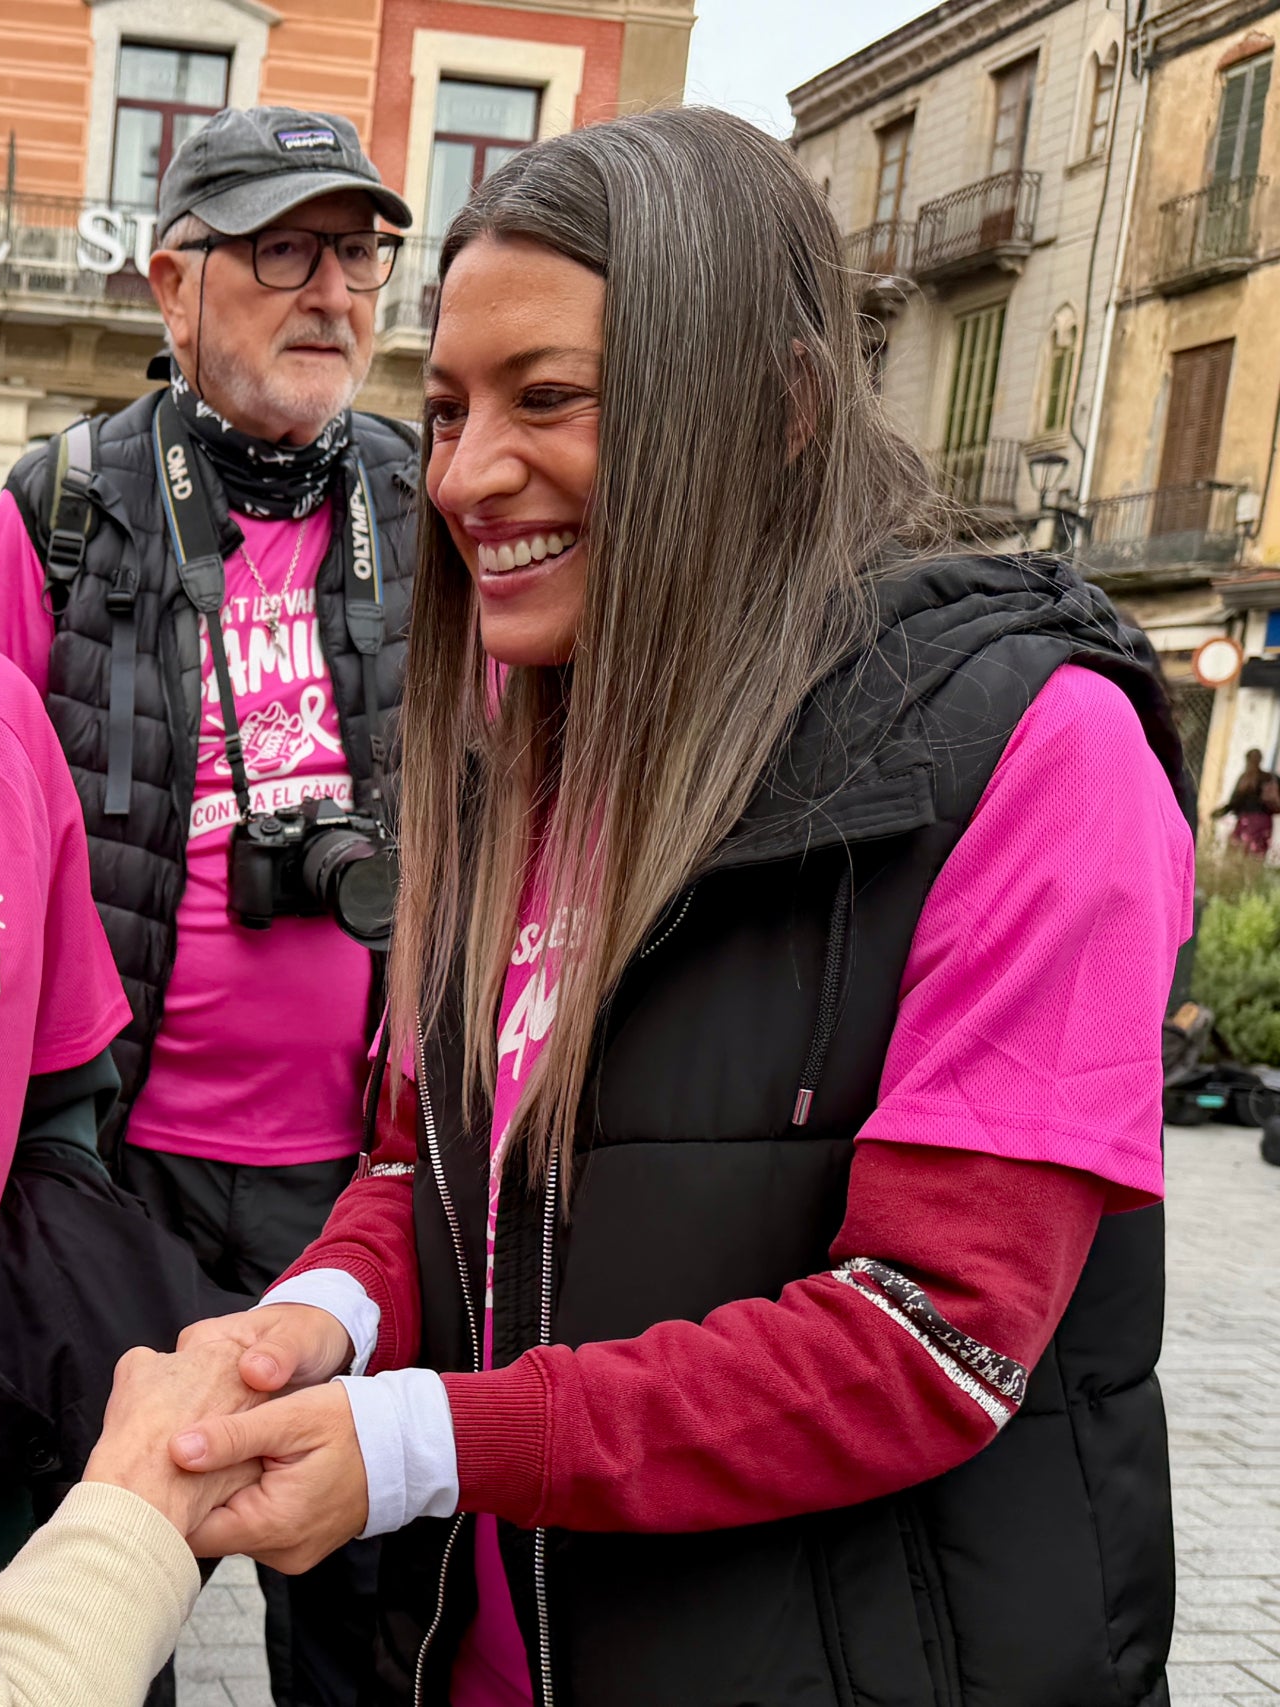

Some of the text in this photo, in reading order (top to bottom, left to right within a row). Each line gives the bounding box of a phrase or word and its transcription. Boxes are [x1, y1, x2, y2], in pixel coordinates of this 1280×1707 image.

[166, 444, 193, 501] OM-D
[193, 791, 267, 828] CONTA
[272, 787, 294, 806] EL
